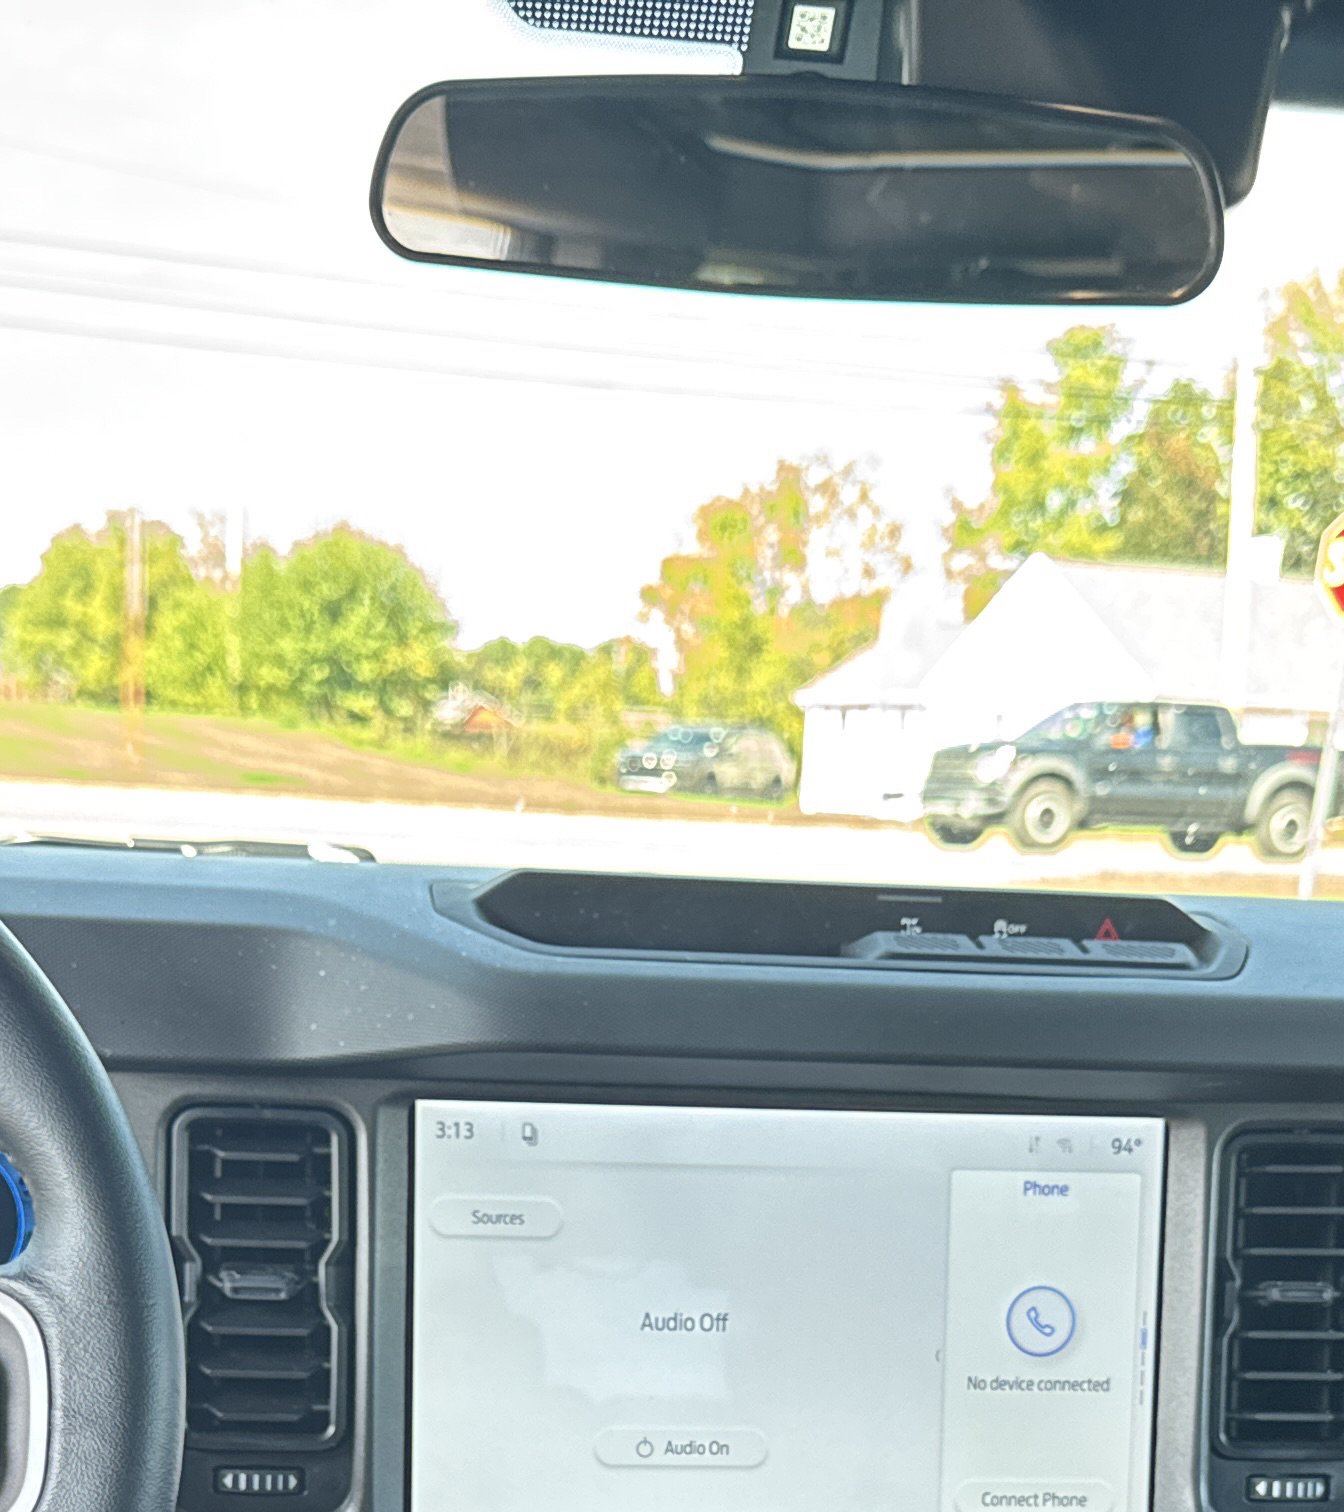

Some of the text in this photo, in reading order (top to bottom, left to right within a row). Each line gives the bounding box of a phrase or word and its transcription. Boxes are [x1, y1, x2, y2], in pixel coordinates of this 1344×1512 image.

[435, 1121, 474, 1139] 3:13
[1023, 1181, 1069, 1197] Phone
[471, 1210, 525, 1226] Sources
[640, 1312, 729, 1332] Audio Off
[967, 1376, 1111, 1392] No device connected
[664, 1440, 730, 1455] Audio On
[981, 1491, 1088, 1507] Connect Phone
